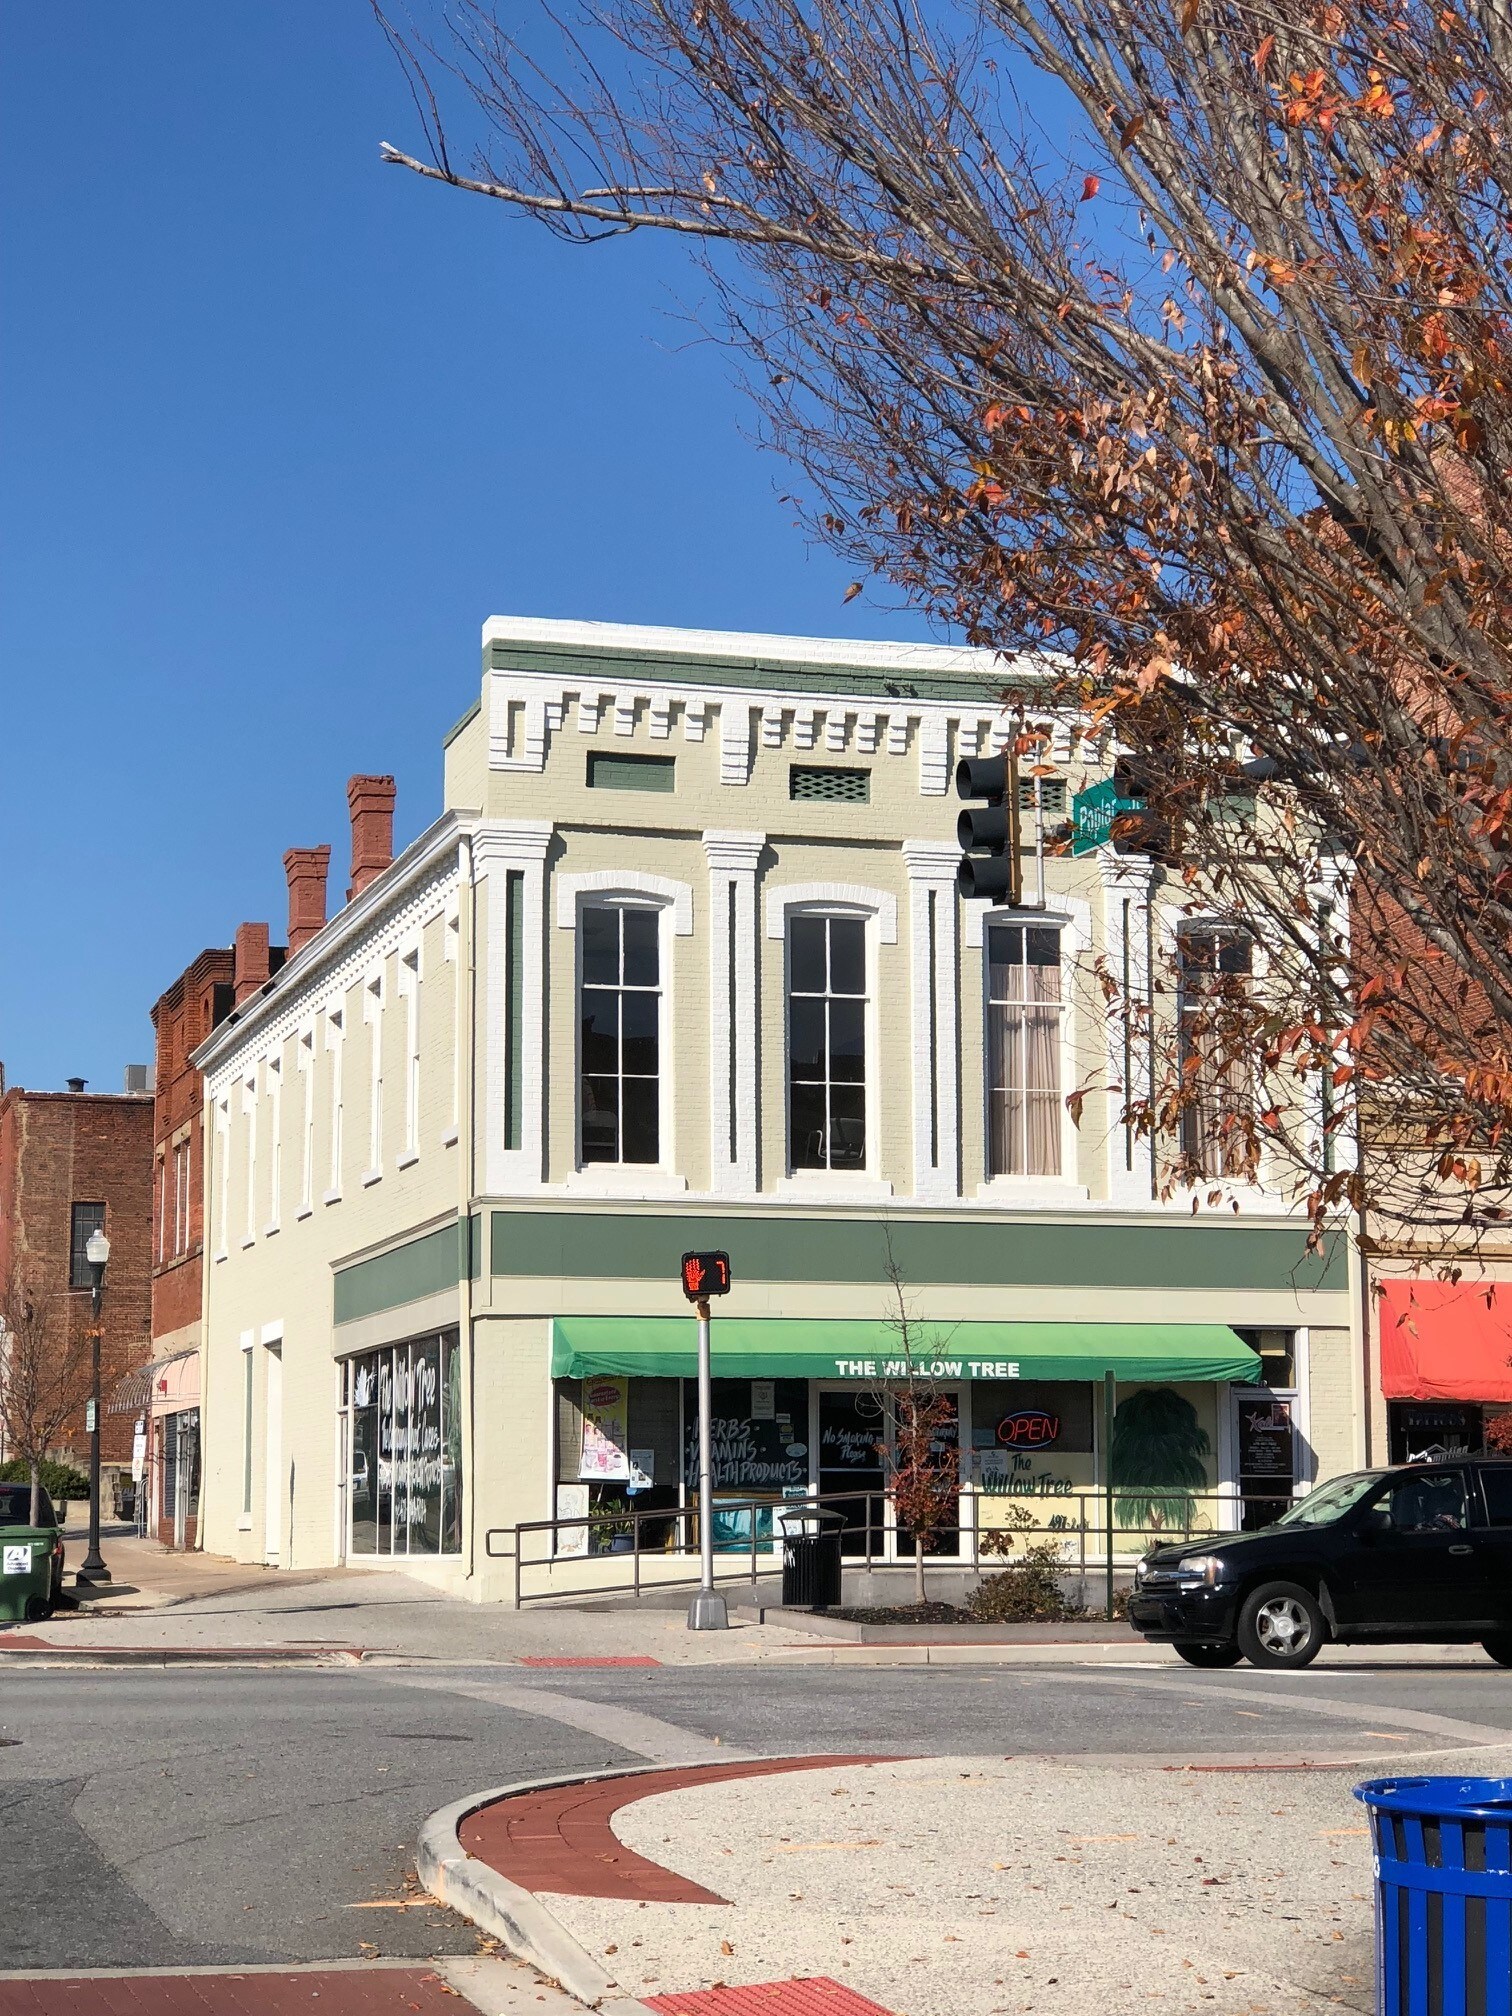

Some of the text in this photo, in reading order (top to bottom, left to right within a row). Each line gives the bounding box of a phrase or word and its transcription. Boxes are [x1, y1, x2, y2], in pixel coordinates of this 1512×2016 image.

[835, 1360, 877, 1376] THE
[968, 1361, 1020, 1378] TREE
[822, 1426, 836, 1445] No
[998, 1417, 1058, 1441] OPEN
[689, 1439, 758, 1461] VAMINS
[1011, 1453, 1032, 1471] The
[686, 1460, 803, 1487] HALTH PRODUCTS
[981, 1472, 1073, 1494] Willow Tree
